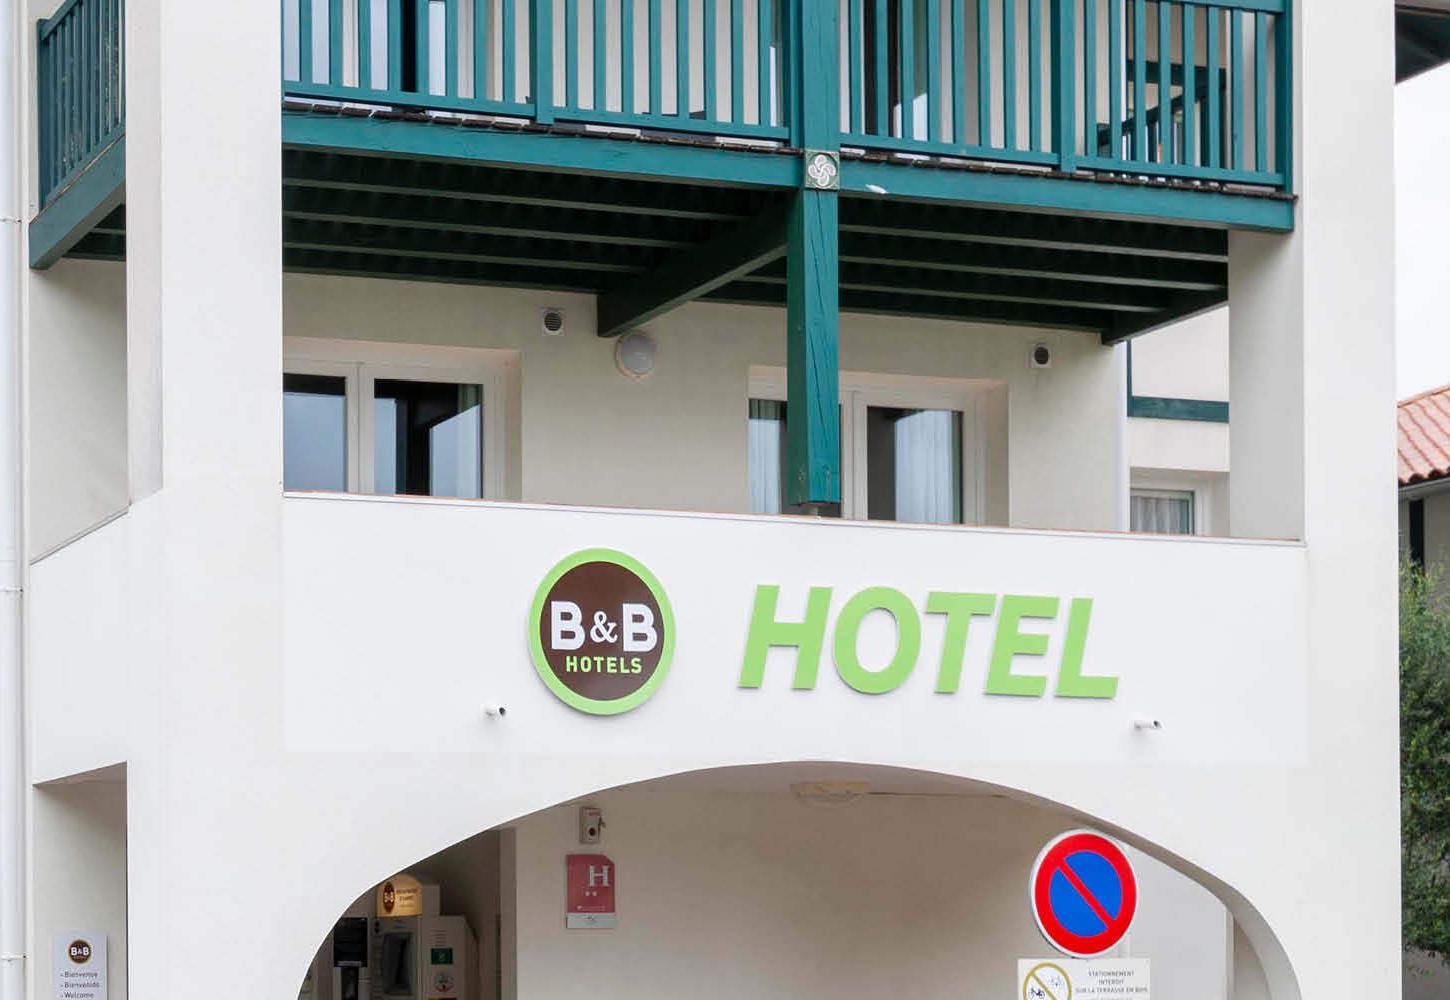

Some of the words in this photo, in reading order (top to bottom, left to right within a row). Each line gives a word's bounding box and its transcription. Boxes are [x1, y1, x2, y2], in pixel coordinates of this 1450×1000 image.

[550, 600, 658, 652] B&B
[738, 584, 1119, 699] HOTEL
[565, 656, 642, 675] HOTELS
[589, 865, 609, 887] H
